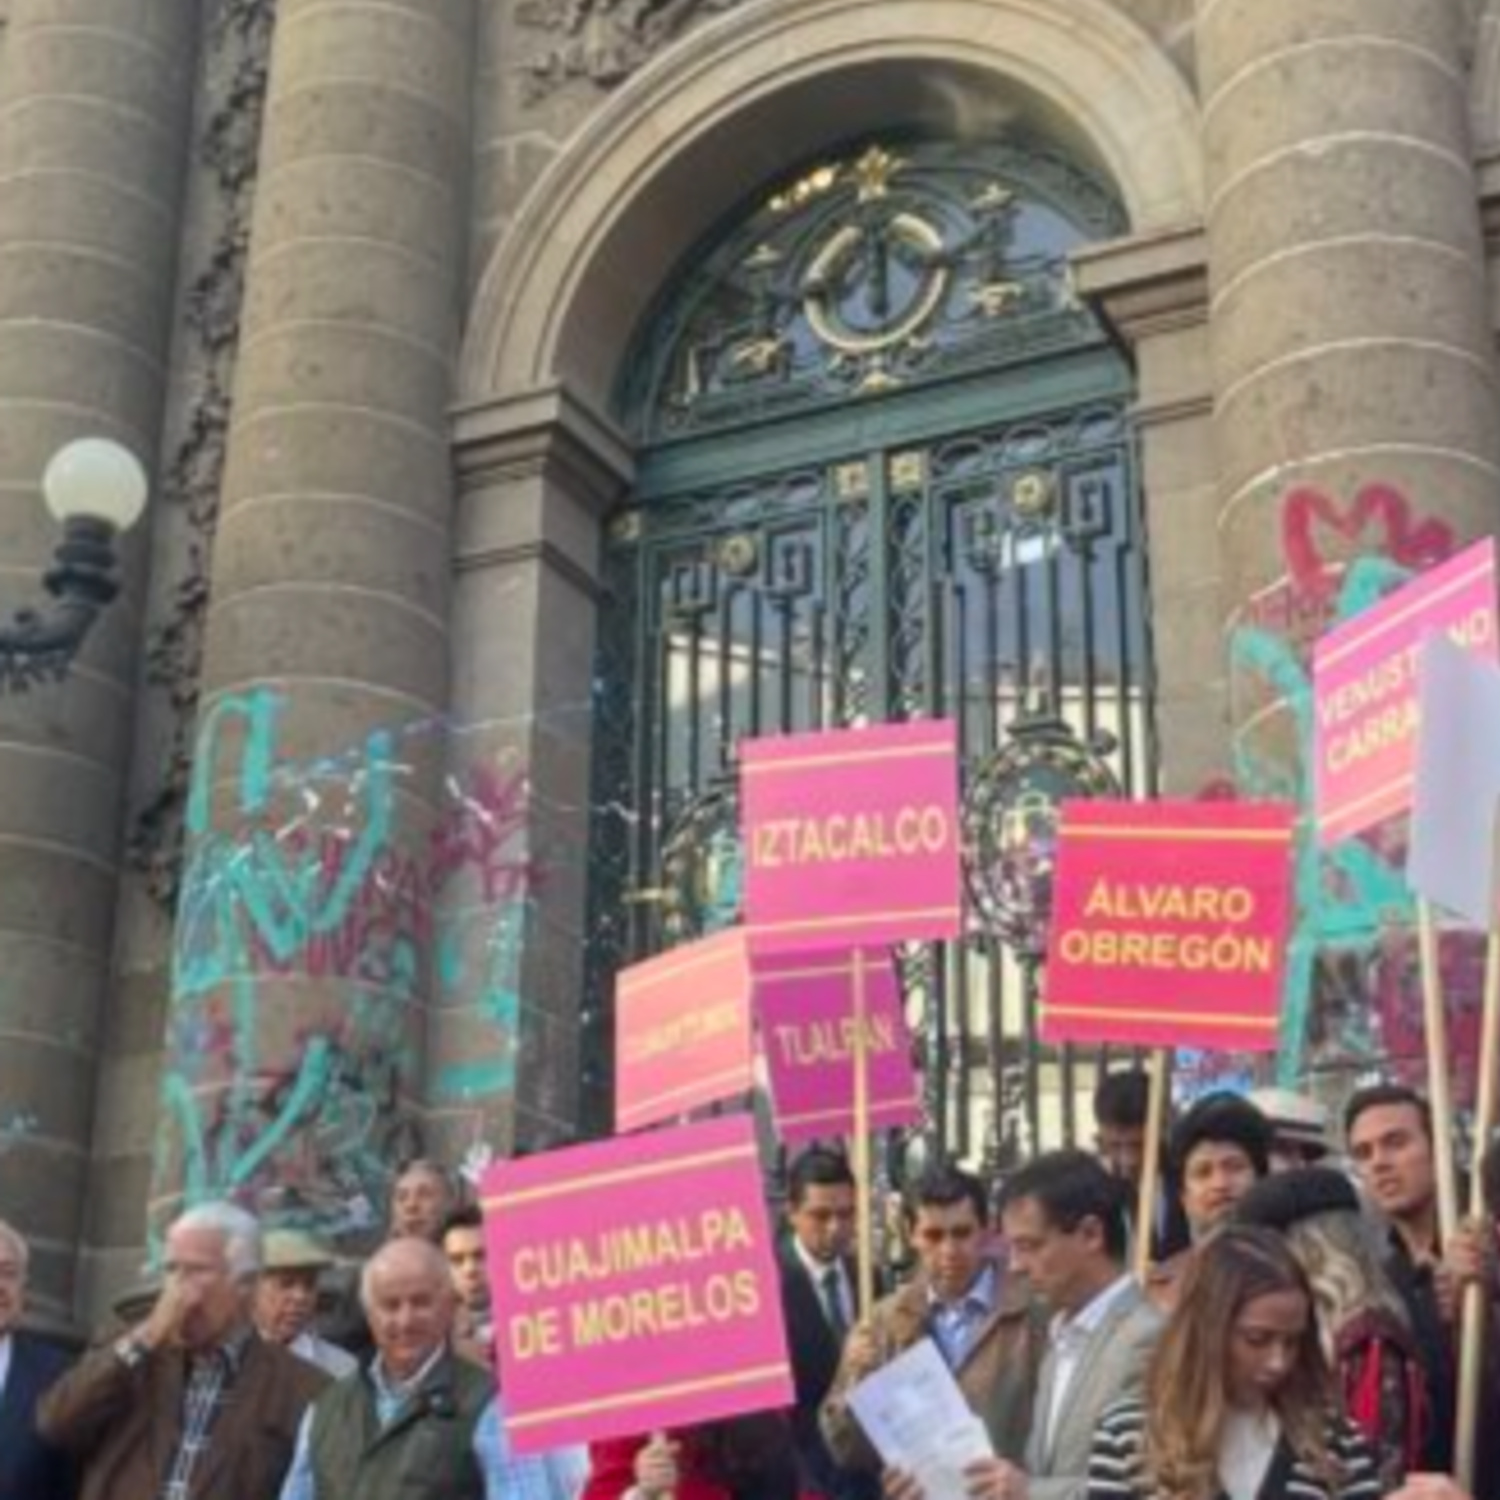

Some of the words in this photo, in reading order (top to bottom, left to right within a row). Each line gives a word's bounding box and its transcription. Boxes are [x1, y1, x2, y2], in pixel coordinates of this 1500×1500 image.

[1321, 607, 1490, 728] VENUSTNO
[1326, 698, 1421, 775] CARRA
[752, 805, 947, 867] IZTACALCO
[1085, 883, 1253, 923] ÁLVARO
[1059, 927, 1273, 972] OBREGÓN
[512, 1207, 752, 1294] CUAJIMALPA
[510, 1310, 563, 1360] DE
[571, 1271, 760, 1346] MORELOS
